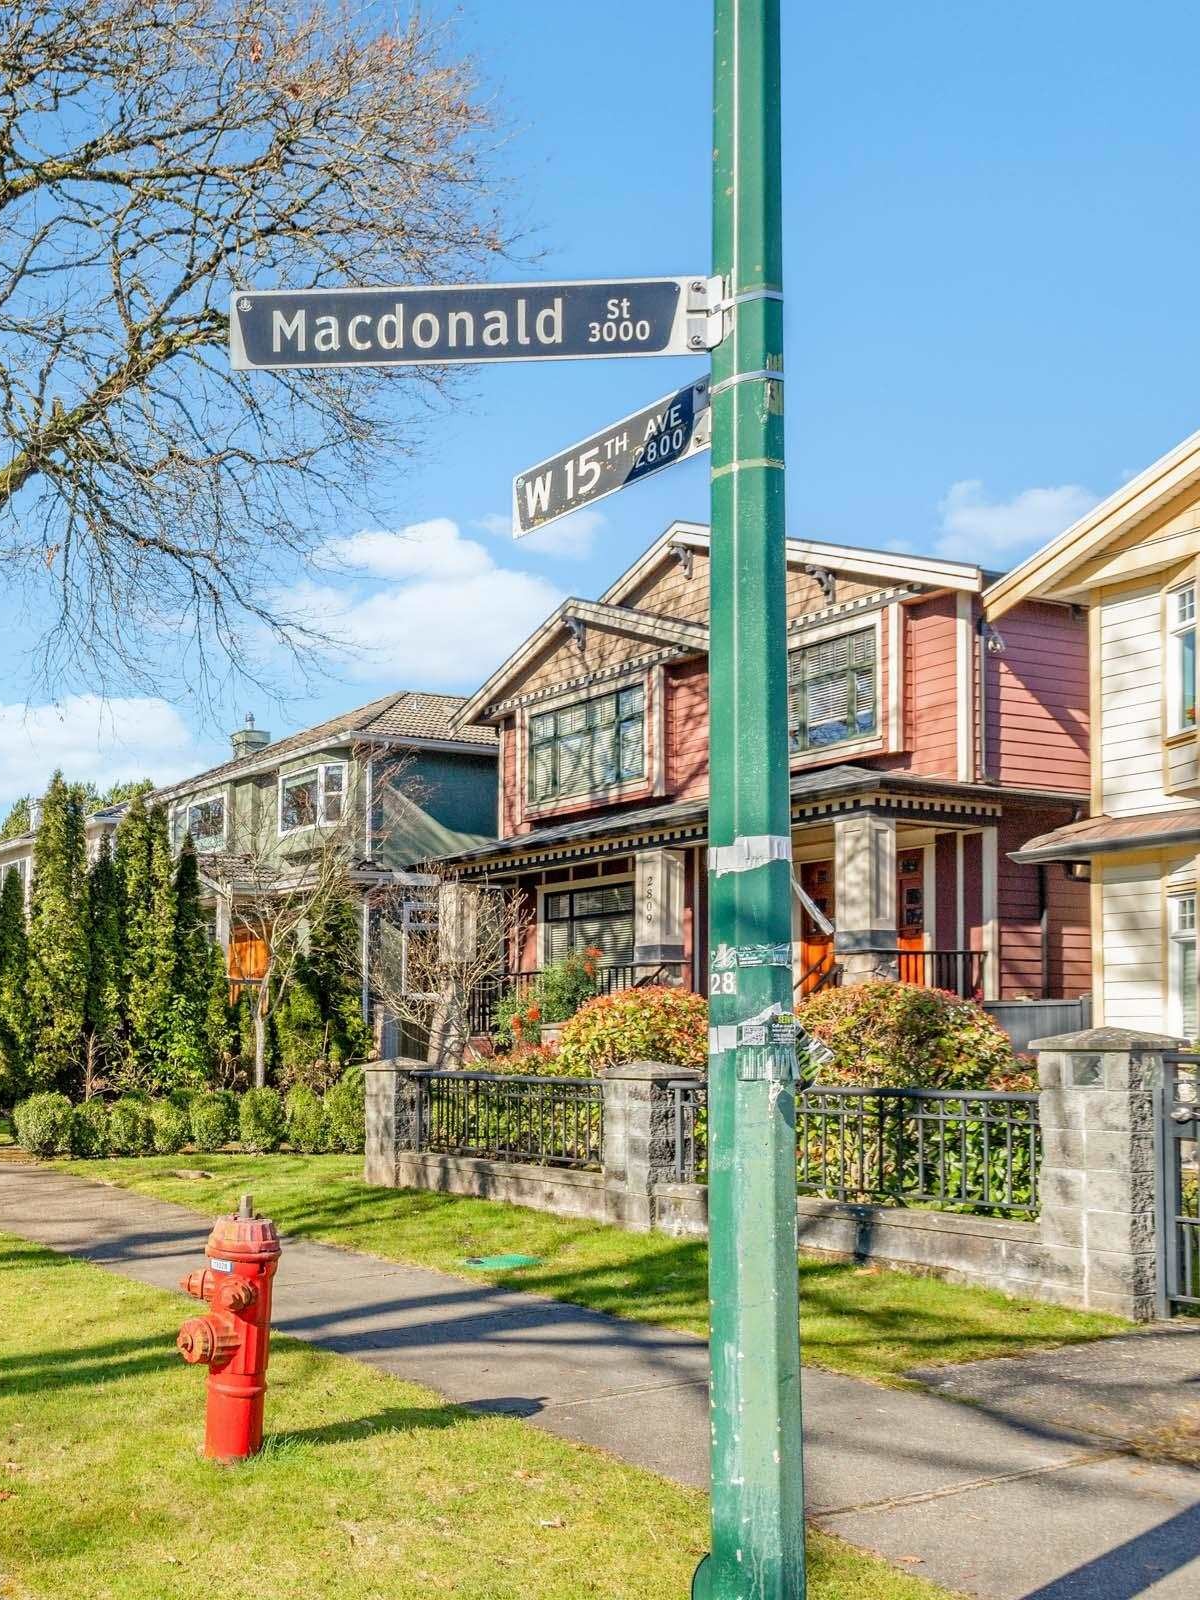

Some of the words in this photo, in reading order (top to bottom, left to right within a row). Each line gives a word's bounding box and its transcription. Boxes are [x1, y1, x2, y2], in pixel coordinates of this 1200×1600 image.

[272, 297, 563, 353] Macdonald
[607, 298, 631, 320] St
[588, 320, 650, 343] 3000
[525, 470, 553, 519] W
[643, 404, 682, 441] AVE
[634, 429, 684, 469] 2800
[646, 875, 654, 924] 2809
[710, 972, 737, 995] 28
